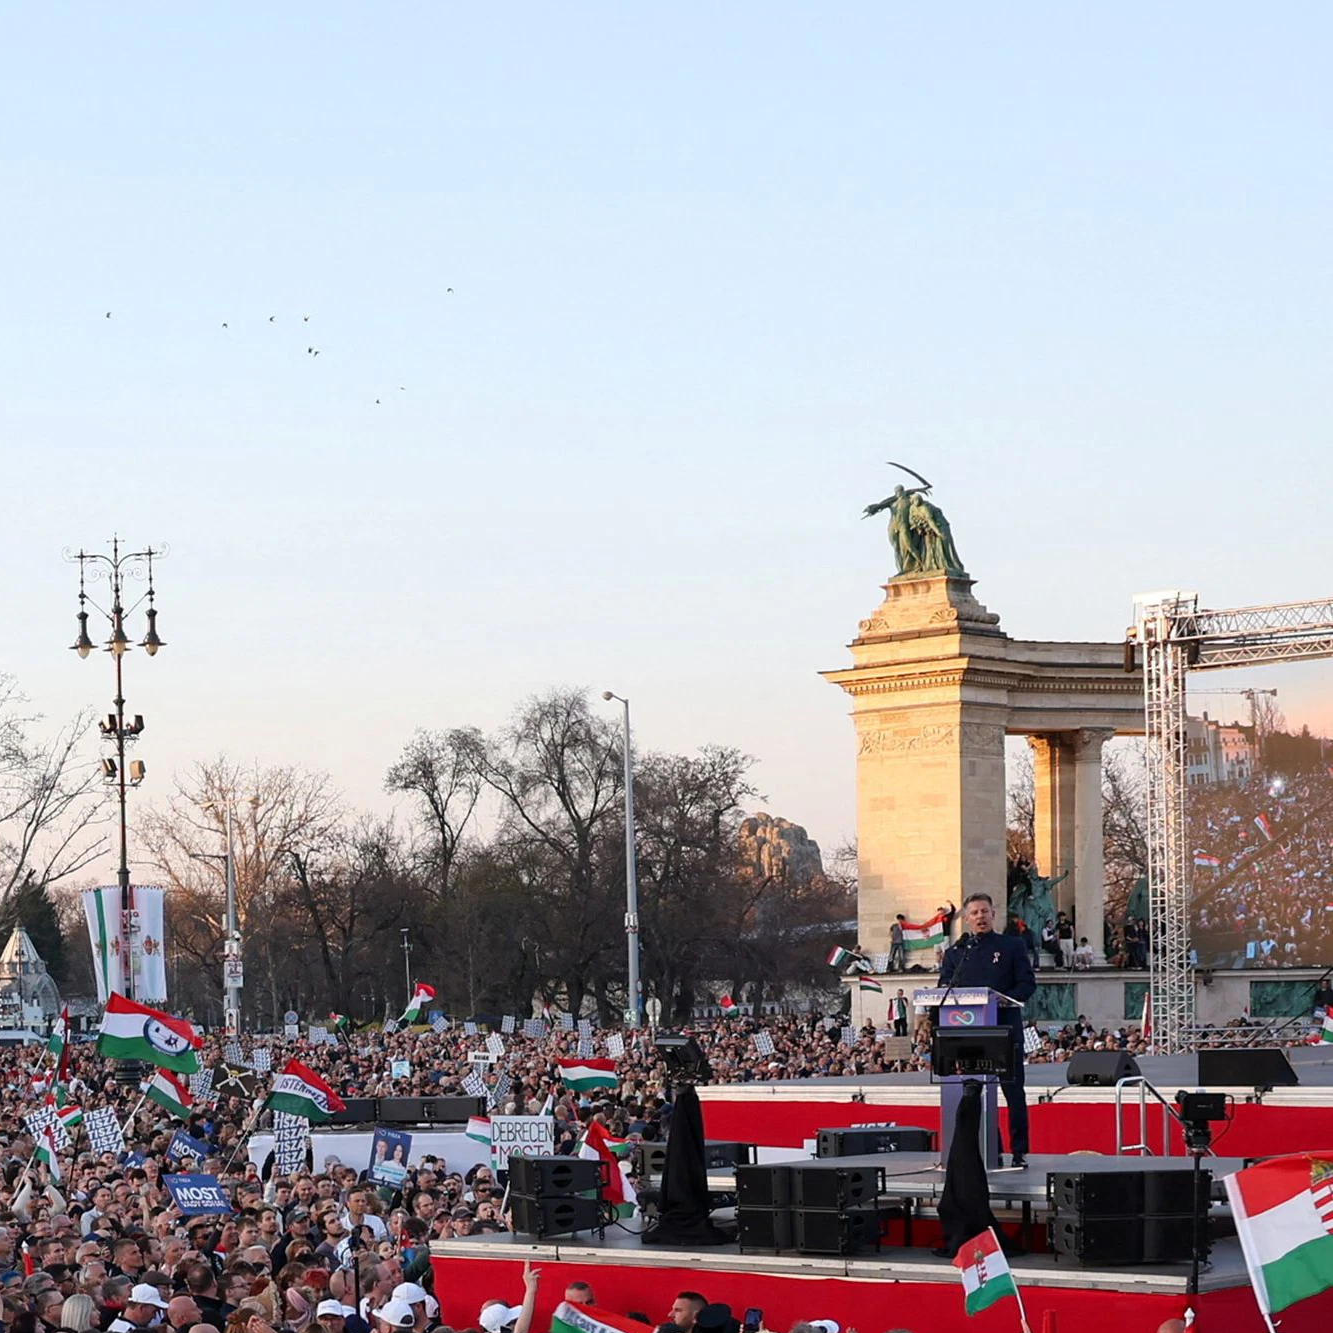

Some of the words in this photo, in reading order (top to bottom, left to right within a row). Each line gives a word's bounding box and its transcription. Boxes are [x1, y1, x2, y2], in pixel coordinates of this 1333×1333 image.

[24, 1105, 54, 1125] TISZA
[83, 1105, 114, 1121] TISZA
[28, 1112, 59, 1134] TISZA
[85, 1115, 118, 1131] TISZA
[88, 1123, 121, 1140] TISZA
[274, 1127, 304, 1141] TISZA
[492, 1121, 553, 1142] DEBRECEN
[91, 1132, 124, 1149] TISZA
[275, 1138, 304, 1153] TISZA
[173, 1139, 202, 1163] MOST
[275, 1149, 306, 1163] TISZA
[175, 1187, 219, 1201] MOST
